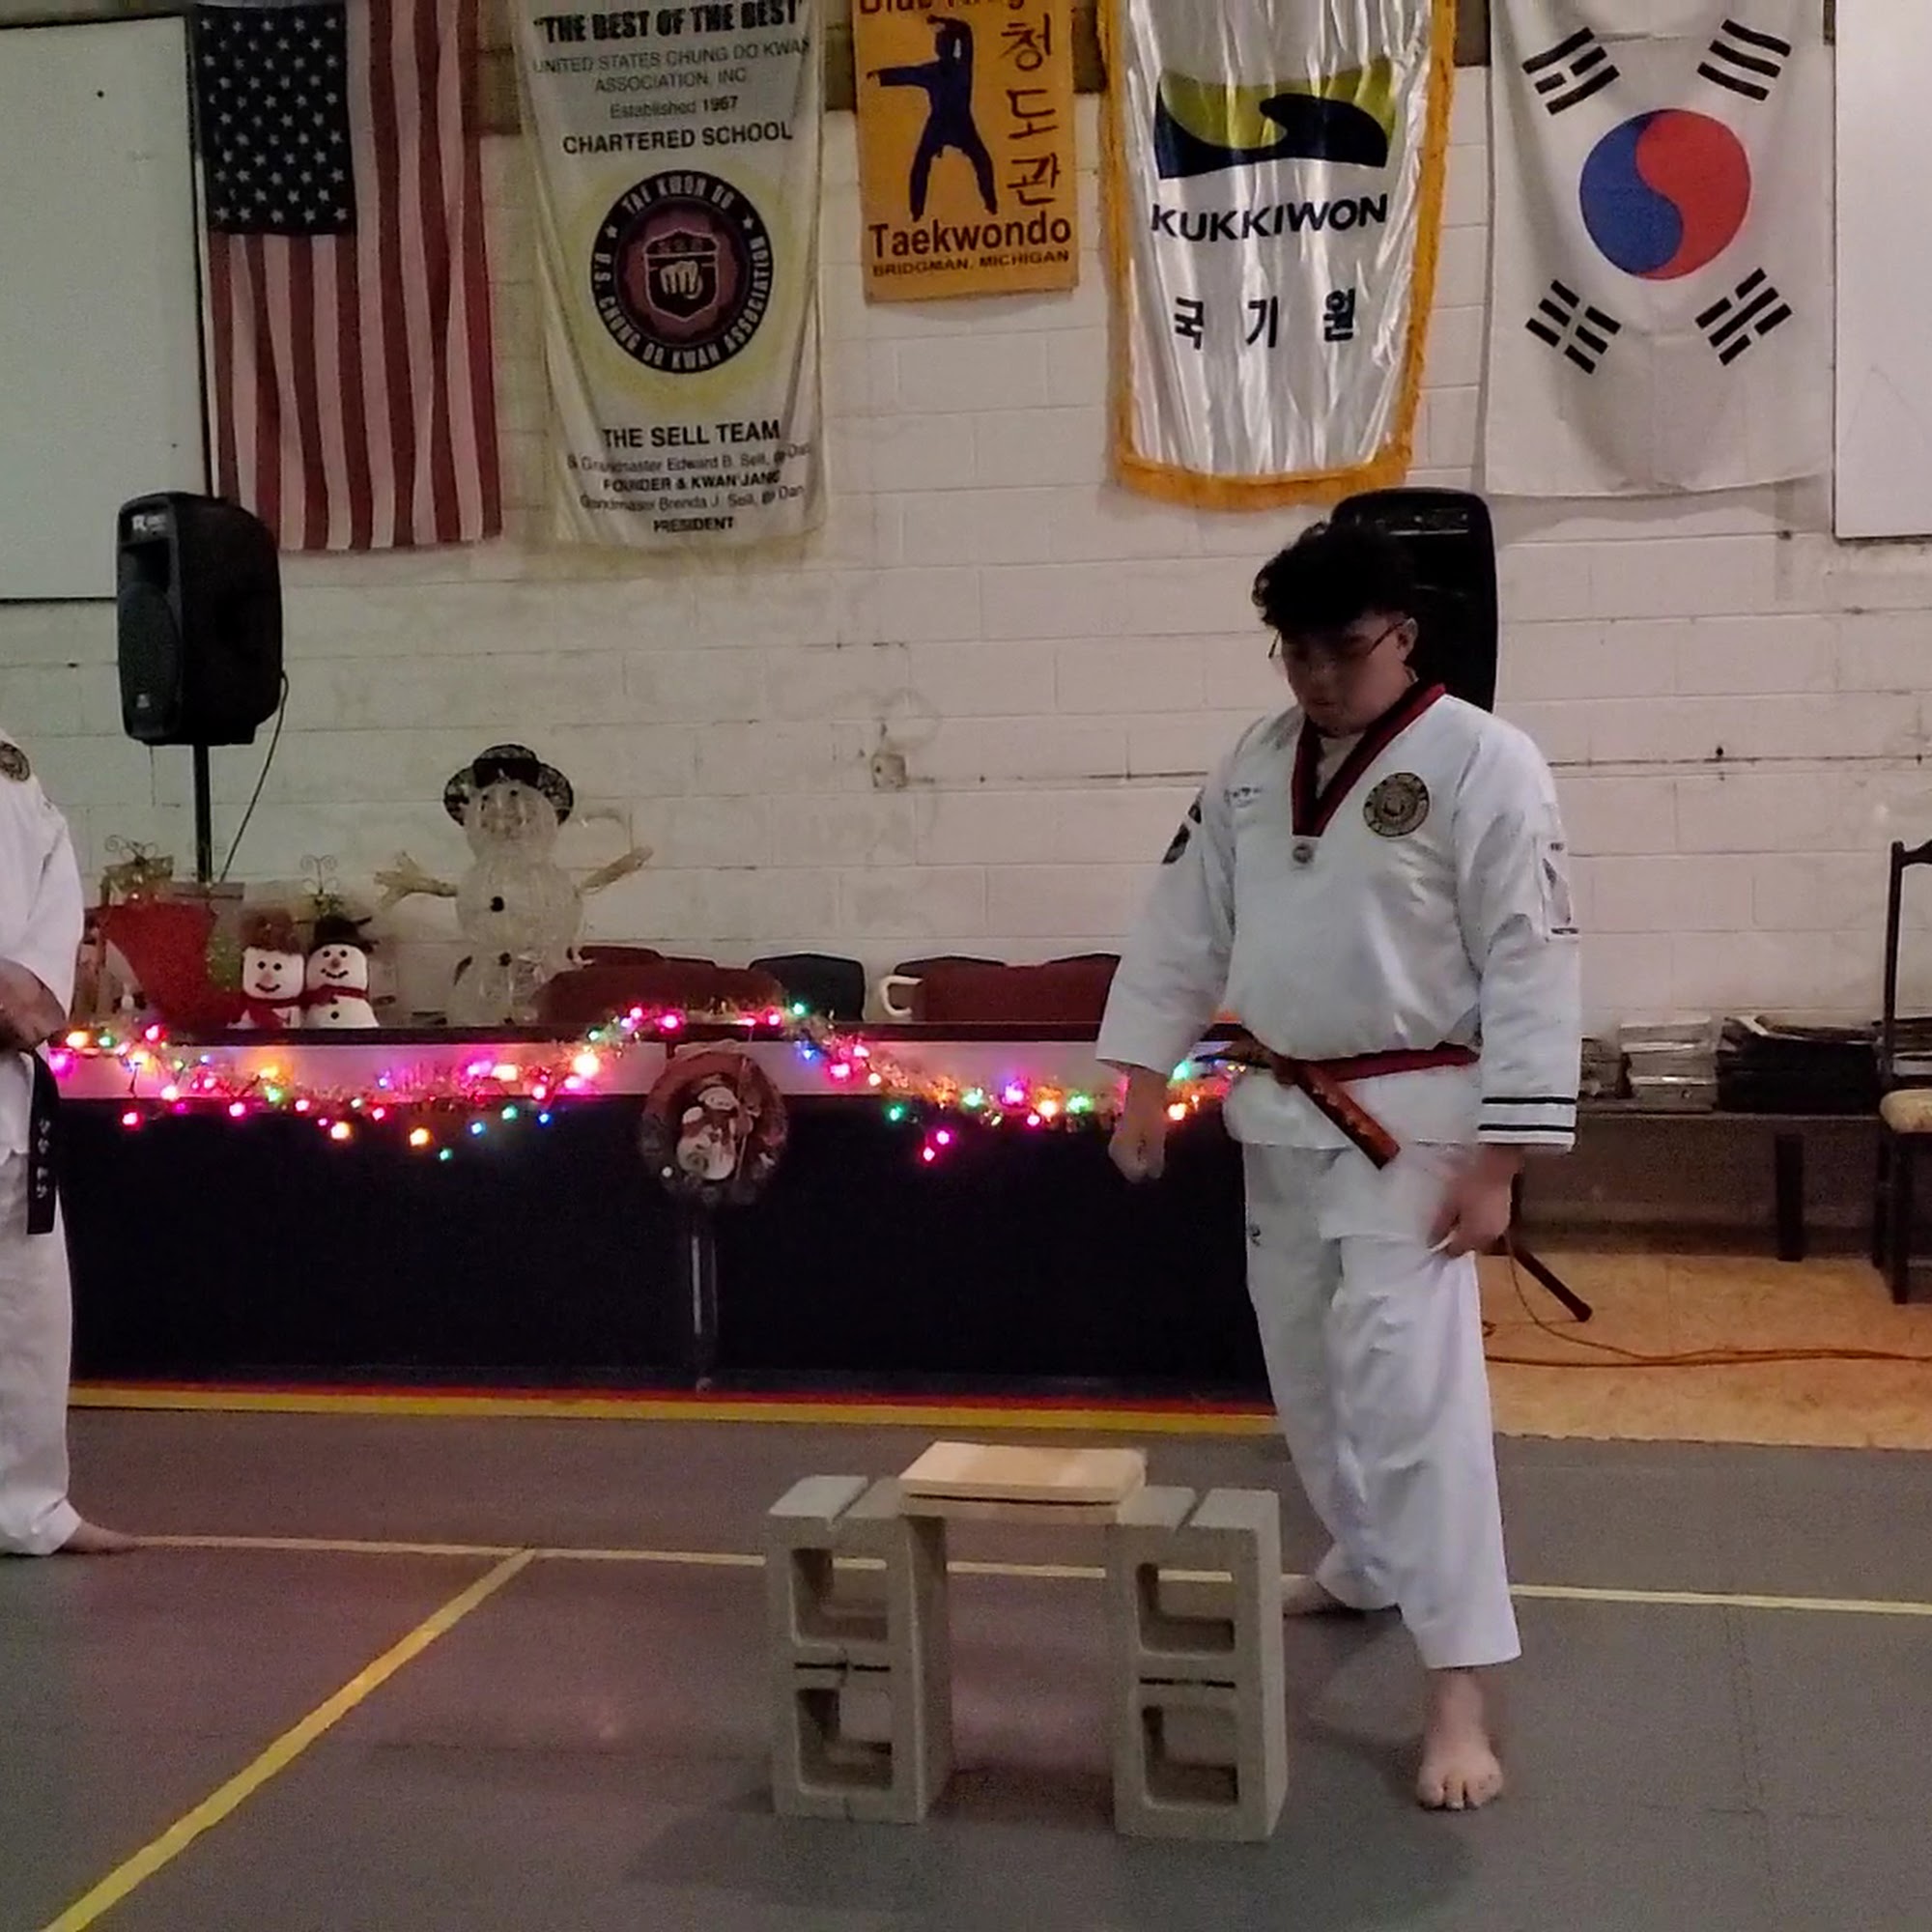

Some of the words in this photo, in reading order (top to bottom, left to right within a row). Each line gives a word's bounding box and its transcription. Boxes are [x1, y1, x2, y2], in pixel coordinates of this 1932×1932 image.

[591, 11, 650, 41] BEST
[656, 8, 687, 37] OF
[689, 3, 735, 33] THE
[532, 56, 594, 73] UNITED
[598, 51, 661, 71] STATES
[666, 46, 728, 67] CHUNG
[733, 43, 758, 60] DO
[762, 38, 811, 58] KWAN
[610, 100, 696, 120] Established
[702, 96, 739, 112] 1967
[562, 128, 695, 155] CHARTERED
[701, 121, 794, 146] SCHOOL
[655, 175, 707, 196] KWON
[710, 185, 735, 209] DO
[1151, 193, 1389, 242] KUKKIWON
[867, 210, 1071, 258] Taekwondo
[979, 249, 1069, 269] MICHIGAN
[670, 342, 722, 370] KWAN
[601, 428, 643, 449] THE
[650, 424, 710, 447] SELL
[715, 419, 781, 442] TEAM
[666, 455, 718, 471] Edward
[603, 476, 671, 494] FOUNDER
[691, 473, 737, 490] KWAN
[659, 496, 708, 512] Brenda
[653, 516, 734, 532] PRESIDENT
